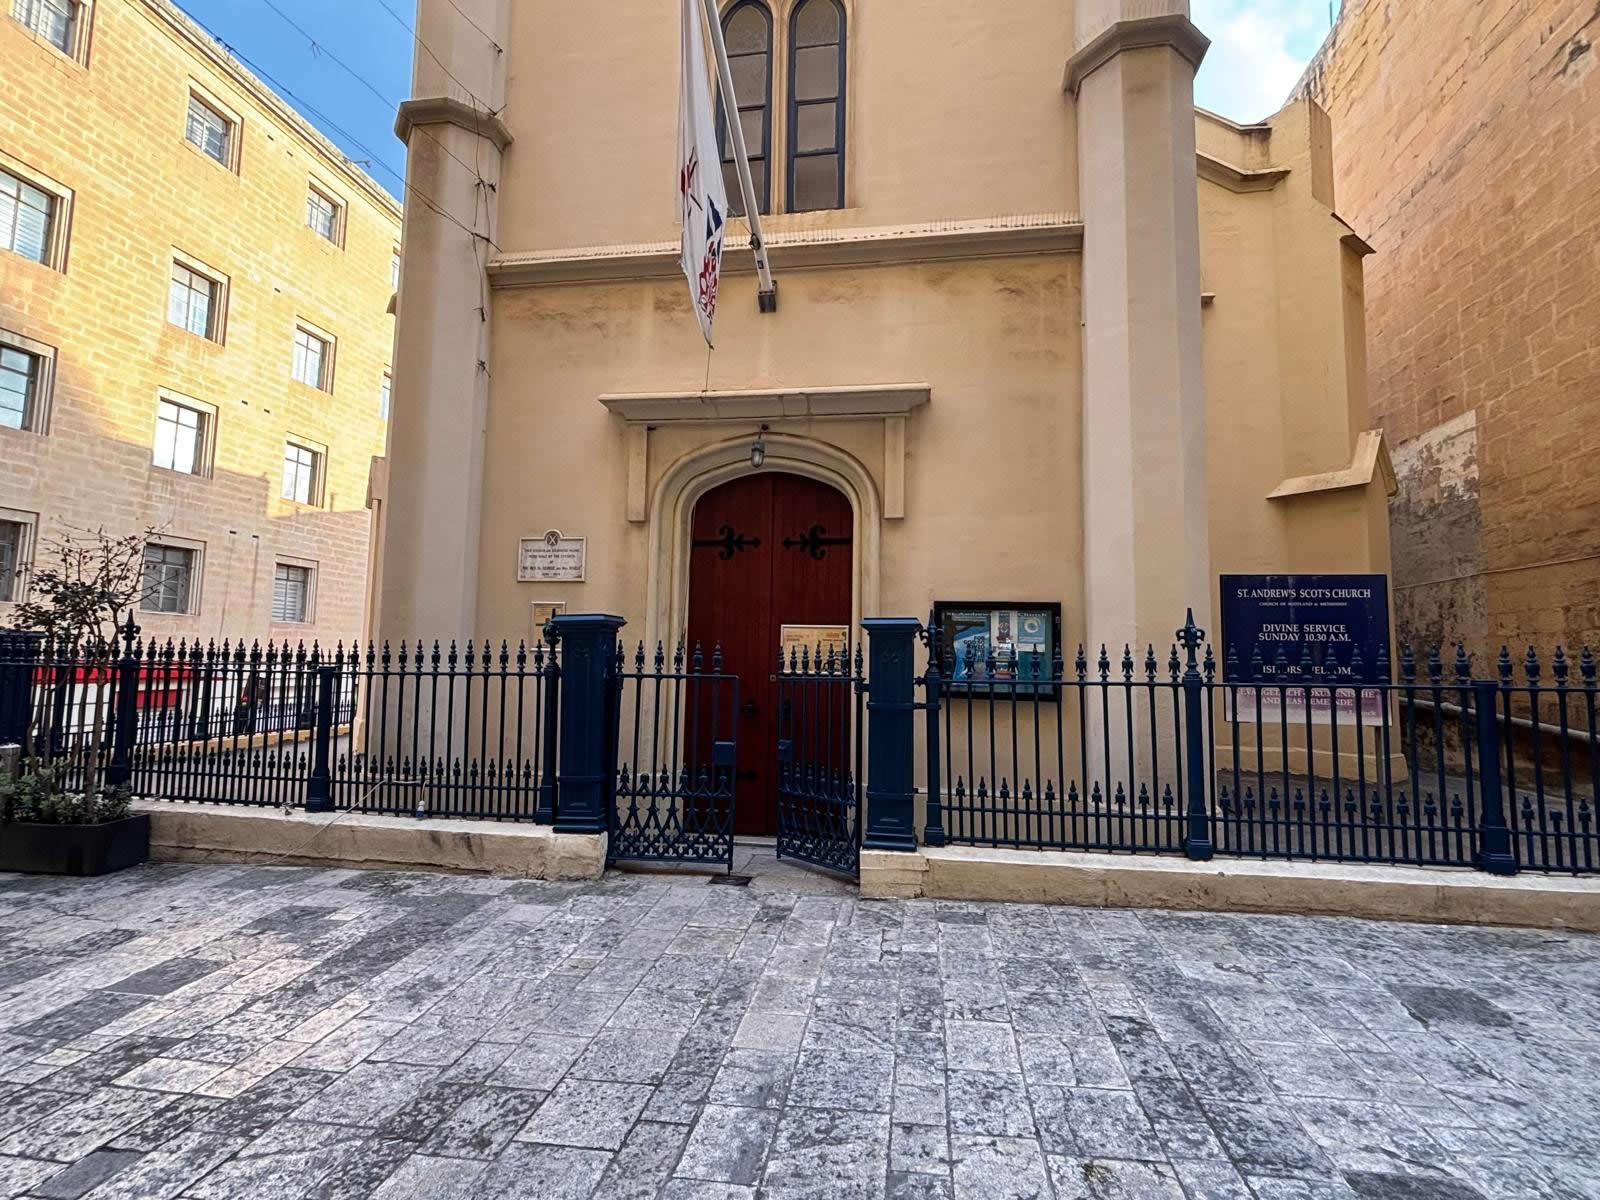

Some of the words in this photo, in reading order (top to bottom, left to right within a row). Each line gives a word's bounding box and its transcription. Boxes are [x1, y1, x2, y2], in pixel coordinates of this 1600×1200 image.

[1237, 588, 1249, 598] ST.
[1250, 588, 1296, 598] ANDREW'S
[1299, 588, 1330, 598] SCOT'S
[1332, 588, 1371, 598] CHURCH
[1263, 624, 1299, 632] DIVINE
[1303, 624, 1346, 632] SERVICE
[1258, 632, 1300, 641] SUNDAY
[1304, 633, 1327, 641] 10.30
[1329, 633, 1351, 642] A.M.
